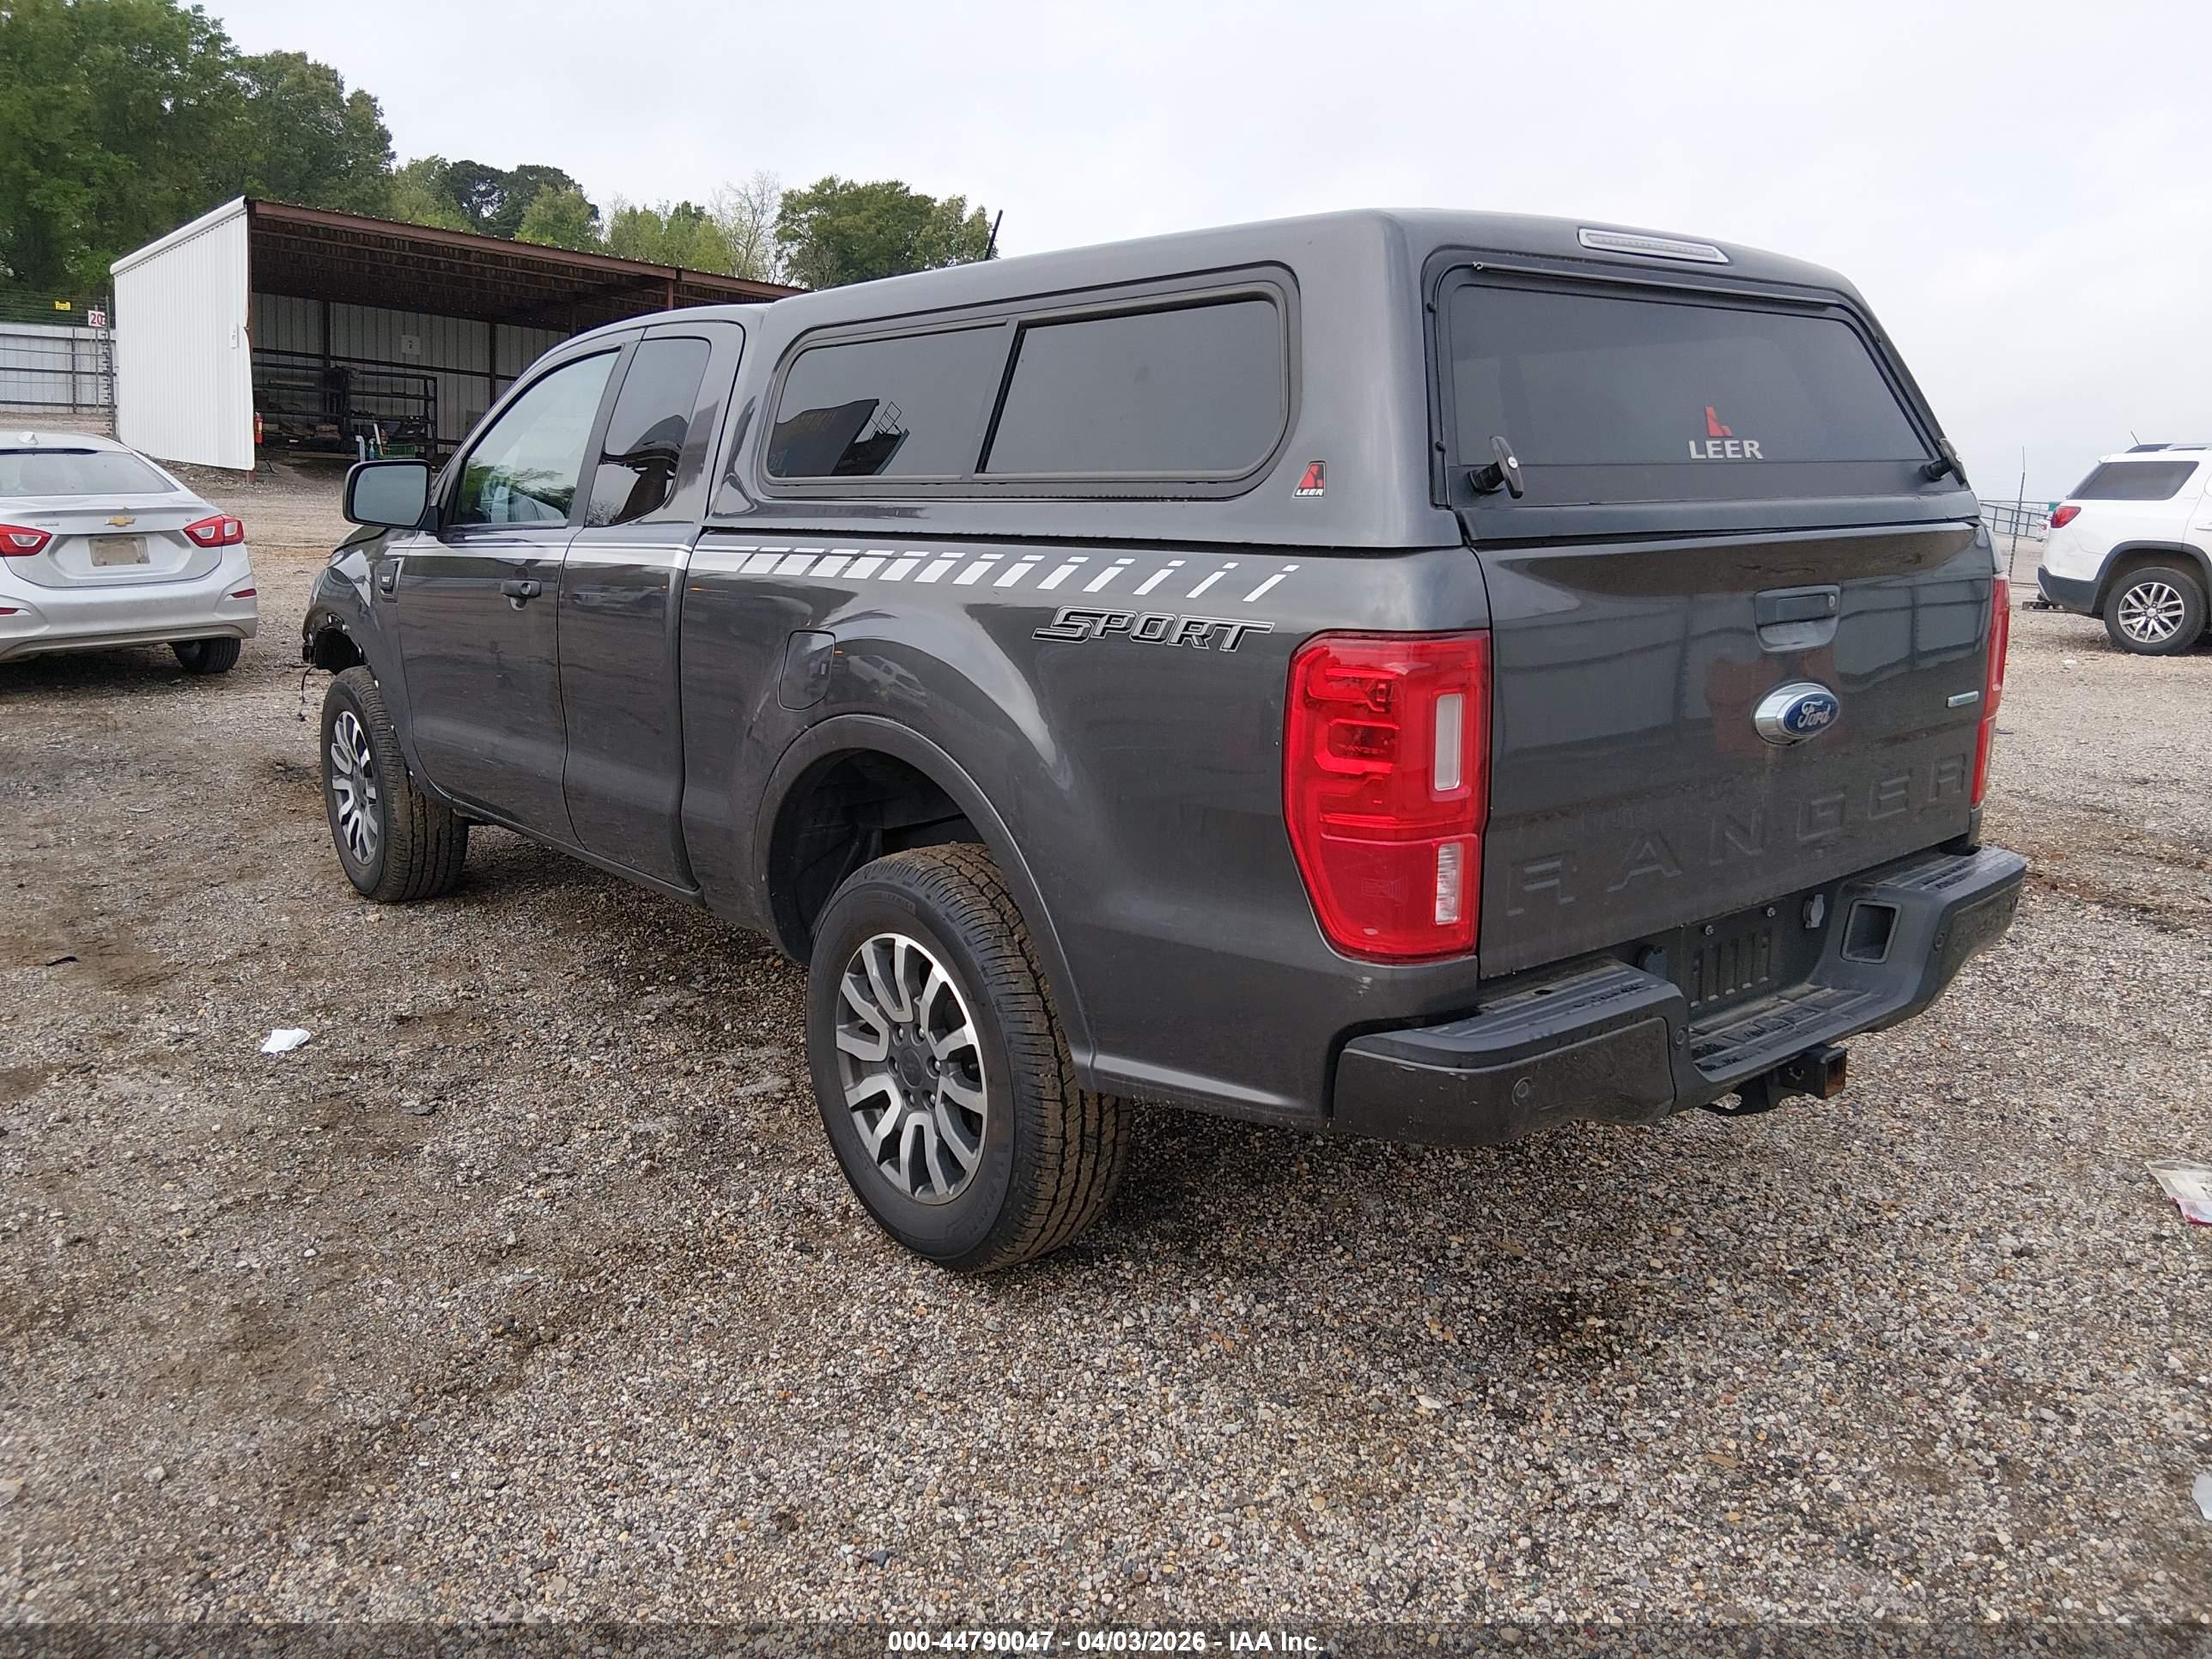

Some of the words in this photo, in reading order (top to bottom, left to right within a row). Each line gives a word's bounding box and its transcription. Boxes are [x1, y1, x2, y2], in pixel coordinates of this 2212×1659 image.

[1688, 439, 1764, 460] LEER
[1295, 488, 1324, 496] LEER
[1032, 605, 1275, 653] SPORT
[1796, 700, 1832, 729] Ford
[1504, 752, 1967, 917] RANGER
